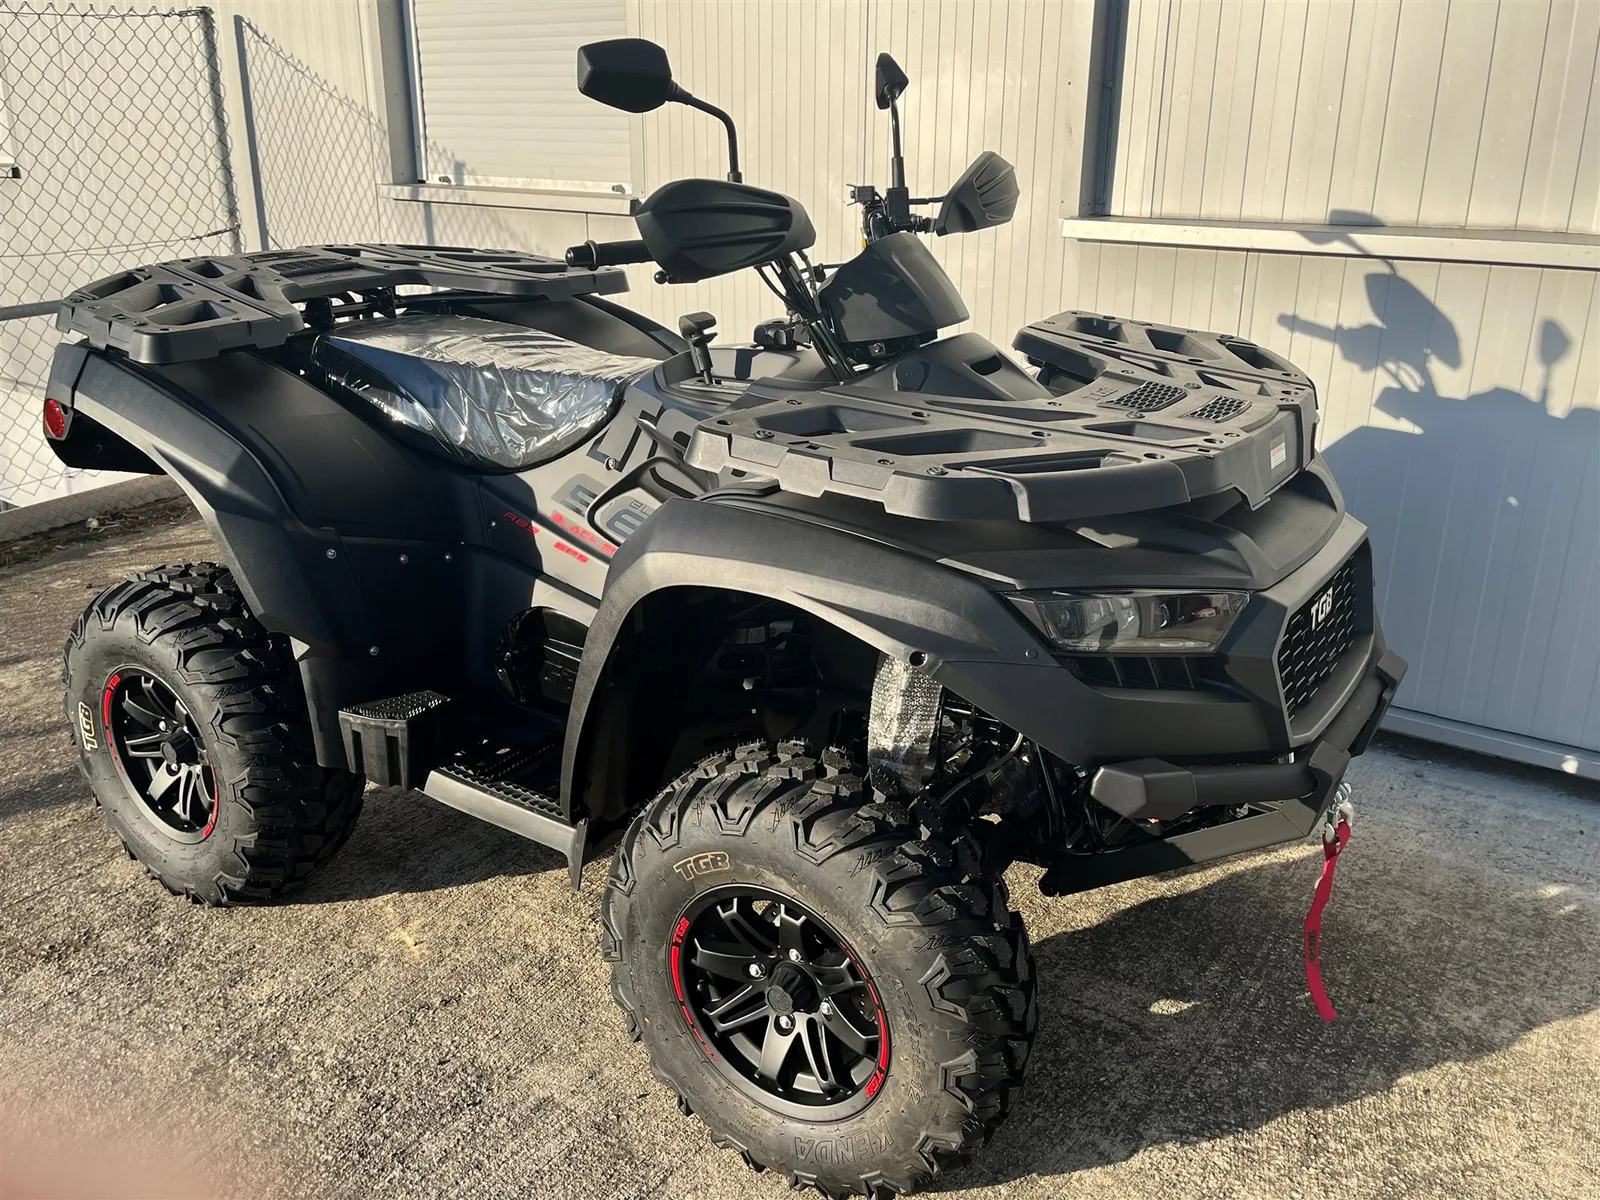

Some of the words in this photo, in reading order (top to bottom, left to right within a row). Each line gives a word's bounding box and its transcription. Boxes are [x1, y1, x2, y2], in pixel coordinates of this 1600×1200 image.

[504, 511, 540, 535] ABS
[550, 511, 599, 546] BLACK
[1310, 585, 1333, 632] TGB
[78, 701, 98, 751] TGB
[672, 851, 730, 881] TGB
[672, 916, 690, 944] TGB
[865, 1069, 885, 1099] TGB
[793, 1116, 895, 1165] KENDA
